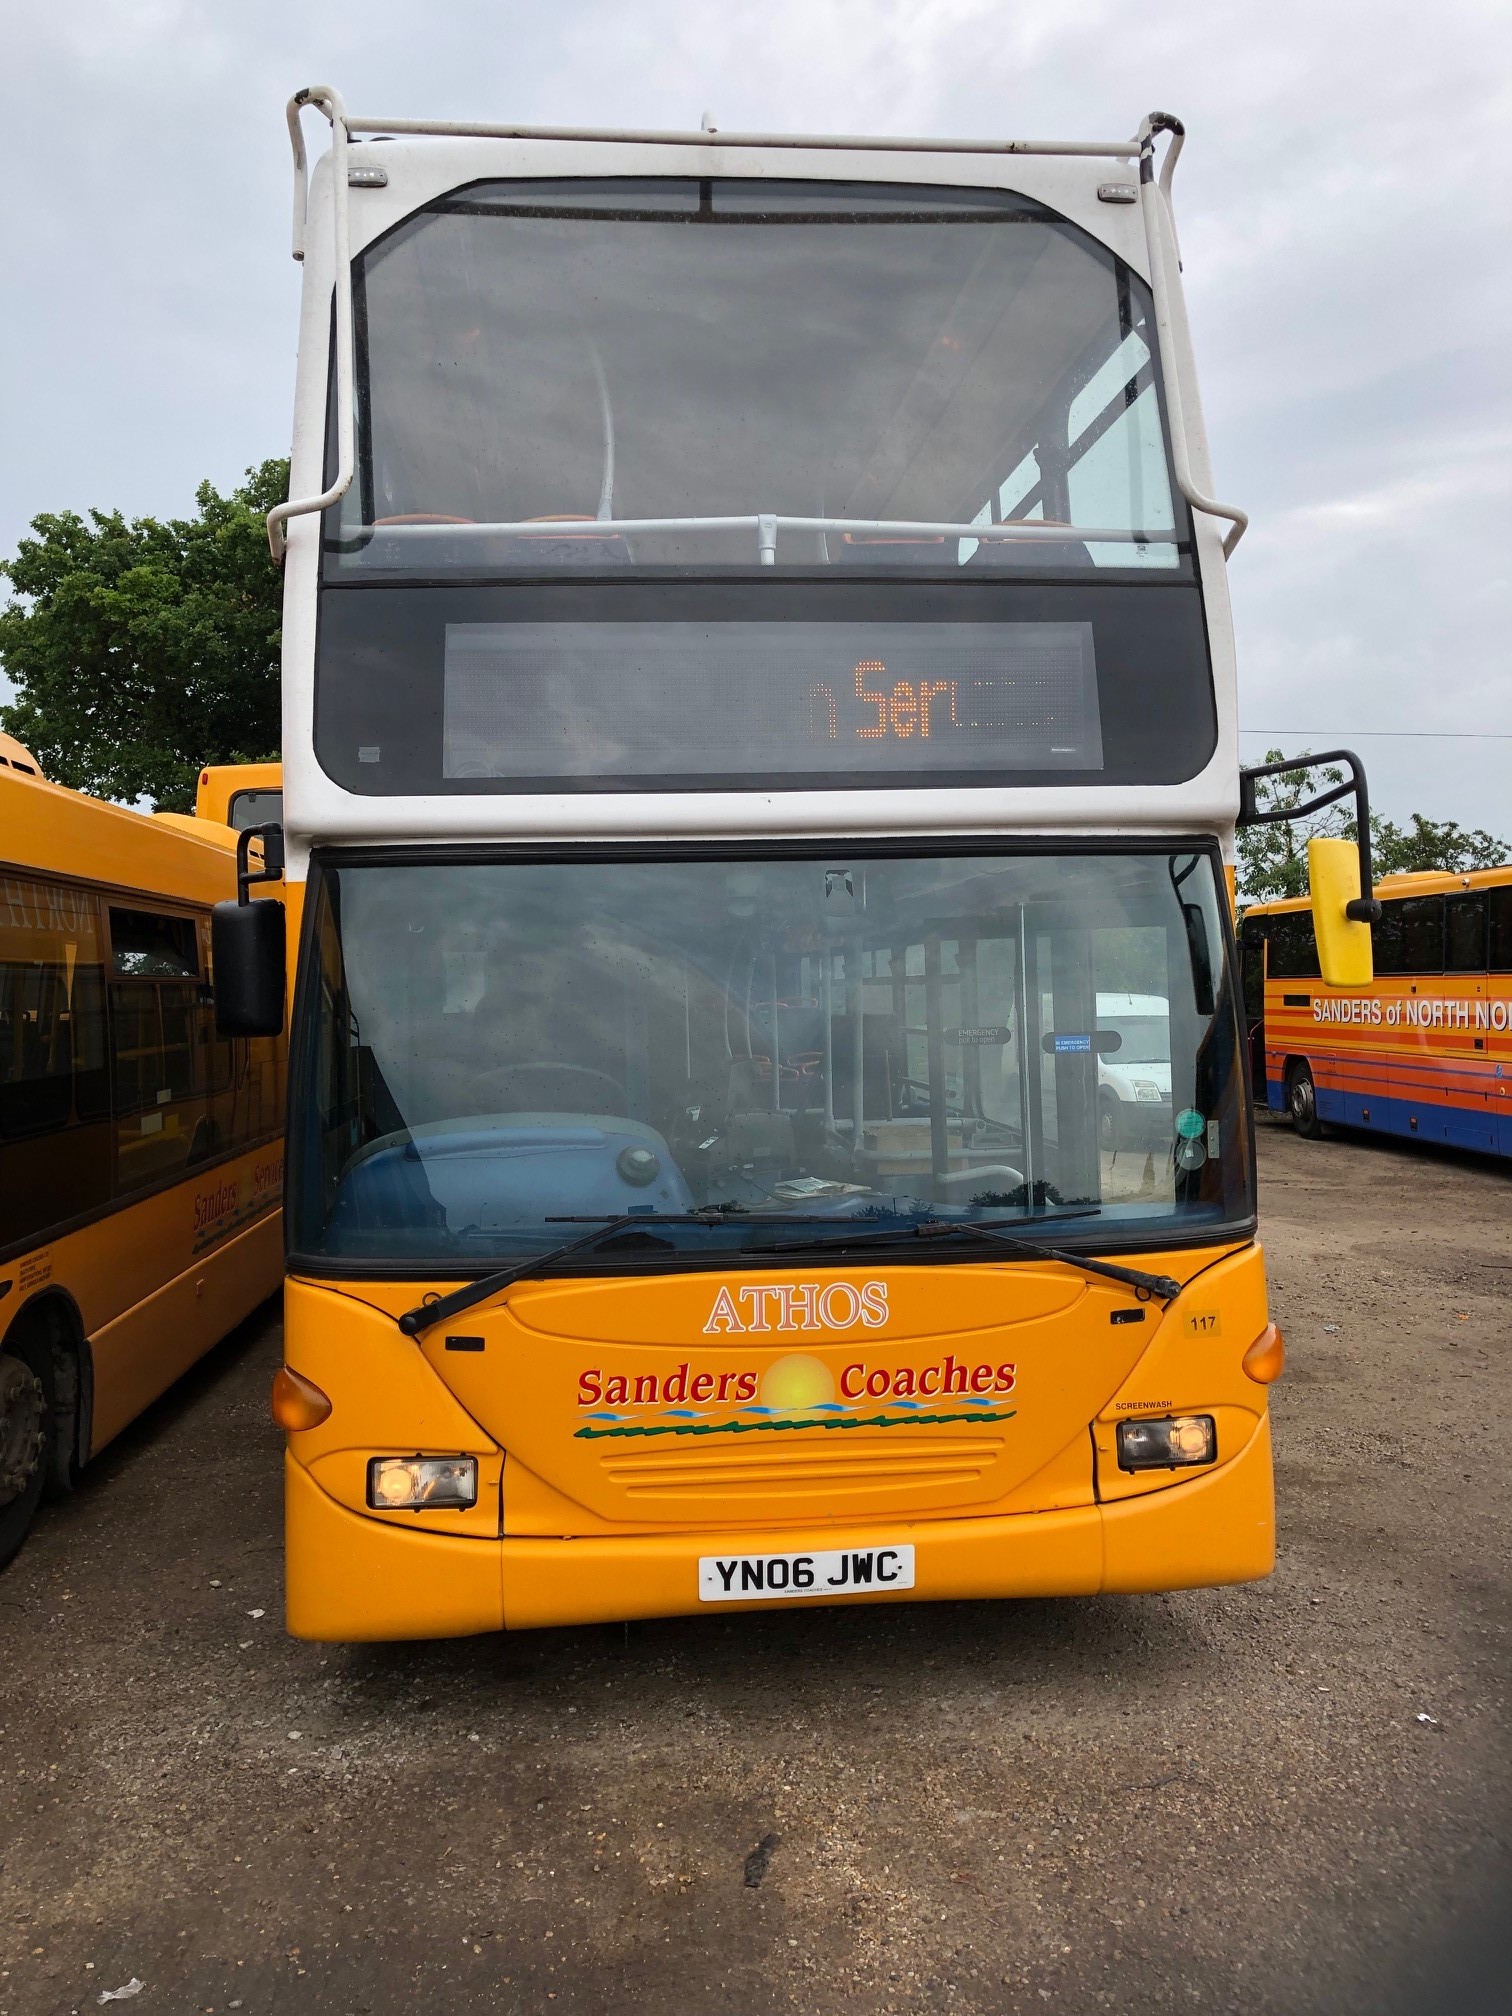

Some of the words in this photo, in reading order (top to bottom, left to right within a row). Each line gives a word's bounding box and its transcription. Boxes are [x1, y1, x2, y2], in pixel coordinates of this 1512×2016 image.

[1313, 998, 1382, 1025] SANDERS
[1386, 1001, 1402, 1026] of
[1406, 1000, 1470, 1029] NORTH
[193, 1180, 238, 1232] Sanders
[703, 1281, 889, 1334] ATHOS
[1190, 1316, 1216, 1331] 117
[577, 1363, 758, 1407] Sanders
[839, 1355, 1017, 1399] Coaches
[1115, 1400, 1173, 1410] SCREENWASH
[715, 1557, 815, 1592] YN06
[826, 1550, 898, 1586] JWC
